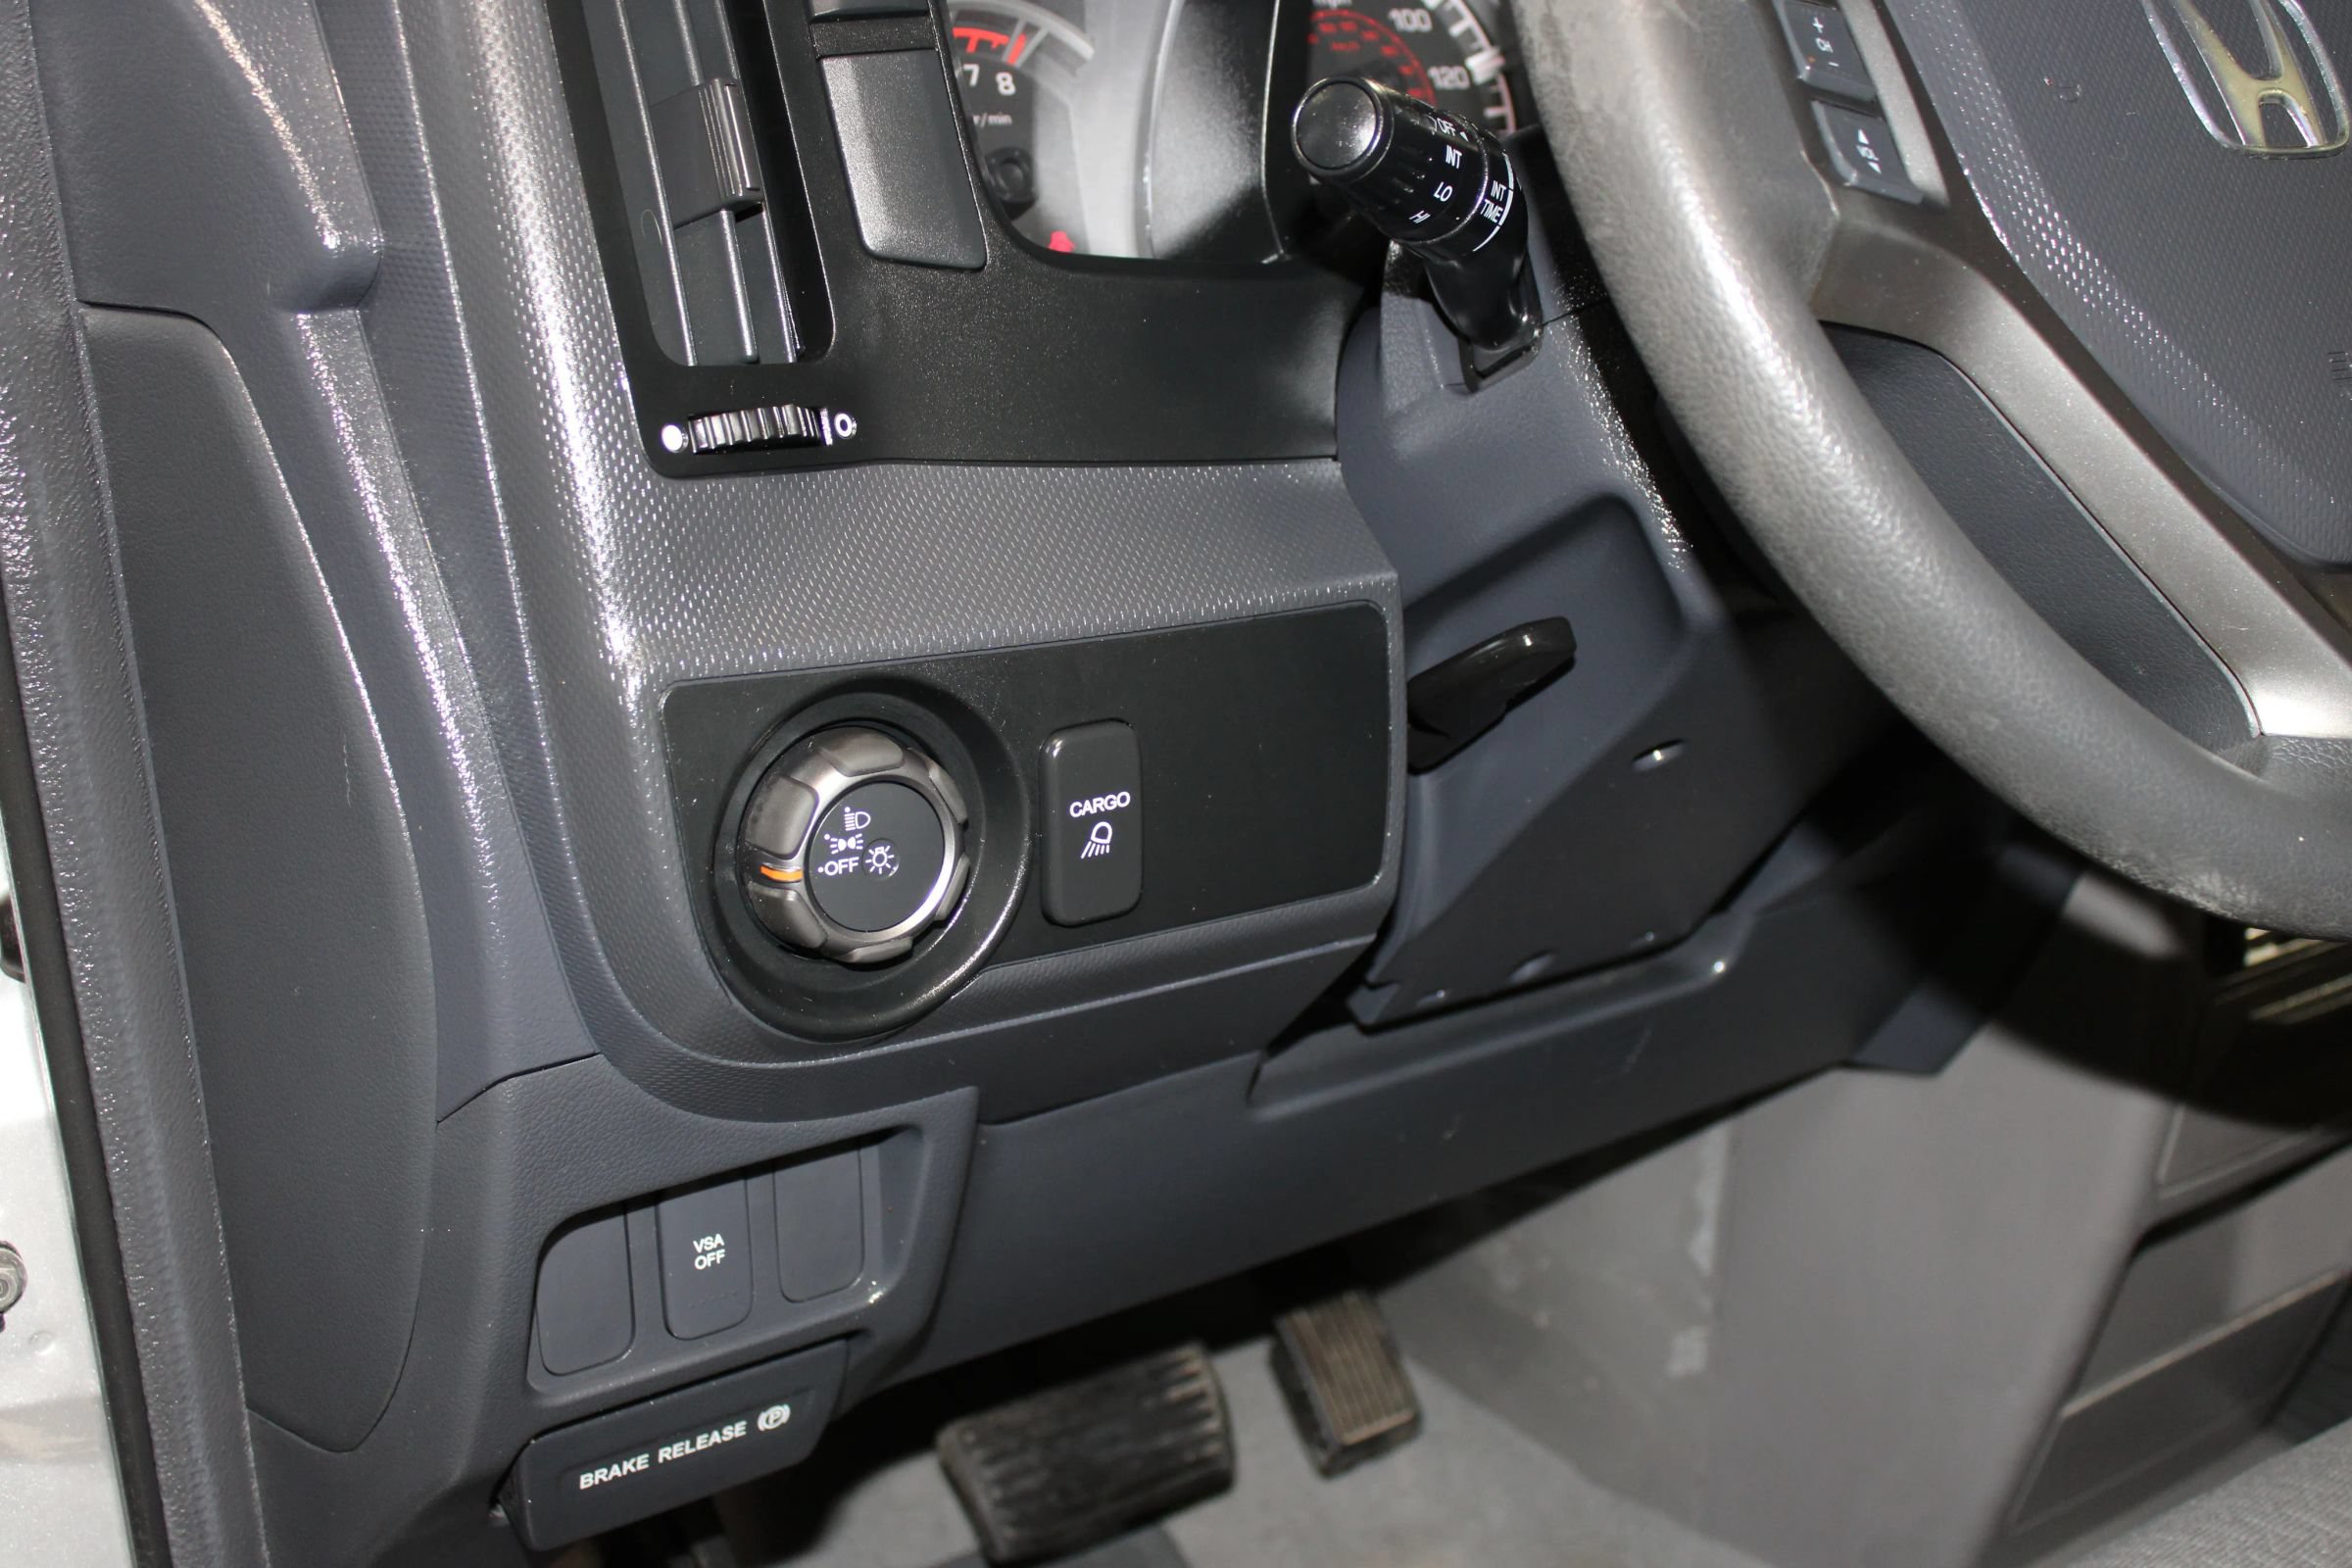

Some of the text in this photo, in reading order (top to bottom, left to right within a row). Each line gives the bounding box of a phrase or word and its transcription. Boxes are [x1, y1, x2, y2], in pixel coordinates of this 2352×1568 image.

[1388, 8, 1433, 32] 100
[962, 63, 980, 87] 7
[995, 72, 1016, 95] 8
[1427, 66, 1470, 90] 120
[1436, 117, 1457, 137] OFF
[1445, 144, 1463, 170] INT
[1433, 181, 1453, 202] LO
[1490, 179, 1507, 202] INT
[1408, 209, 1432, 224] HI
[1480, 198, 1504, 223] TIME
[1069, 791, 1131, 817] CARGO
[824, 856, 859, 876] OFF
[692, 1233, 725, 1253] VSA
[694, 1248, 726, 1270] OFF
[579, 1420, 748, 1491] BRAKE RELEASE
